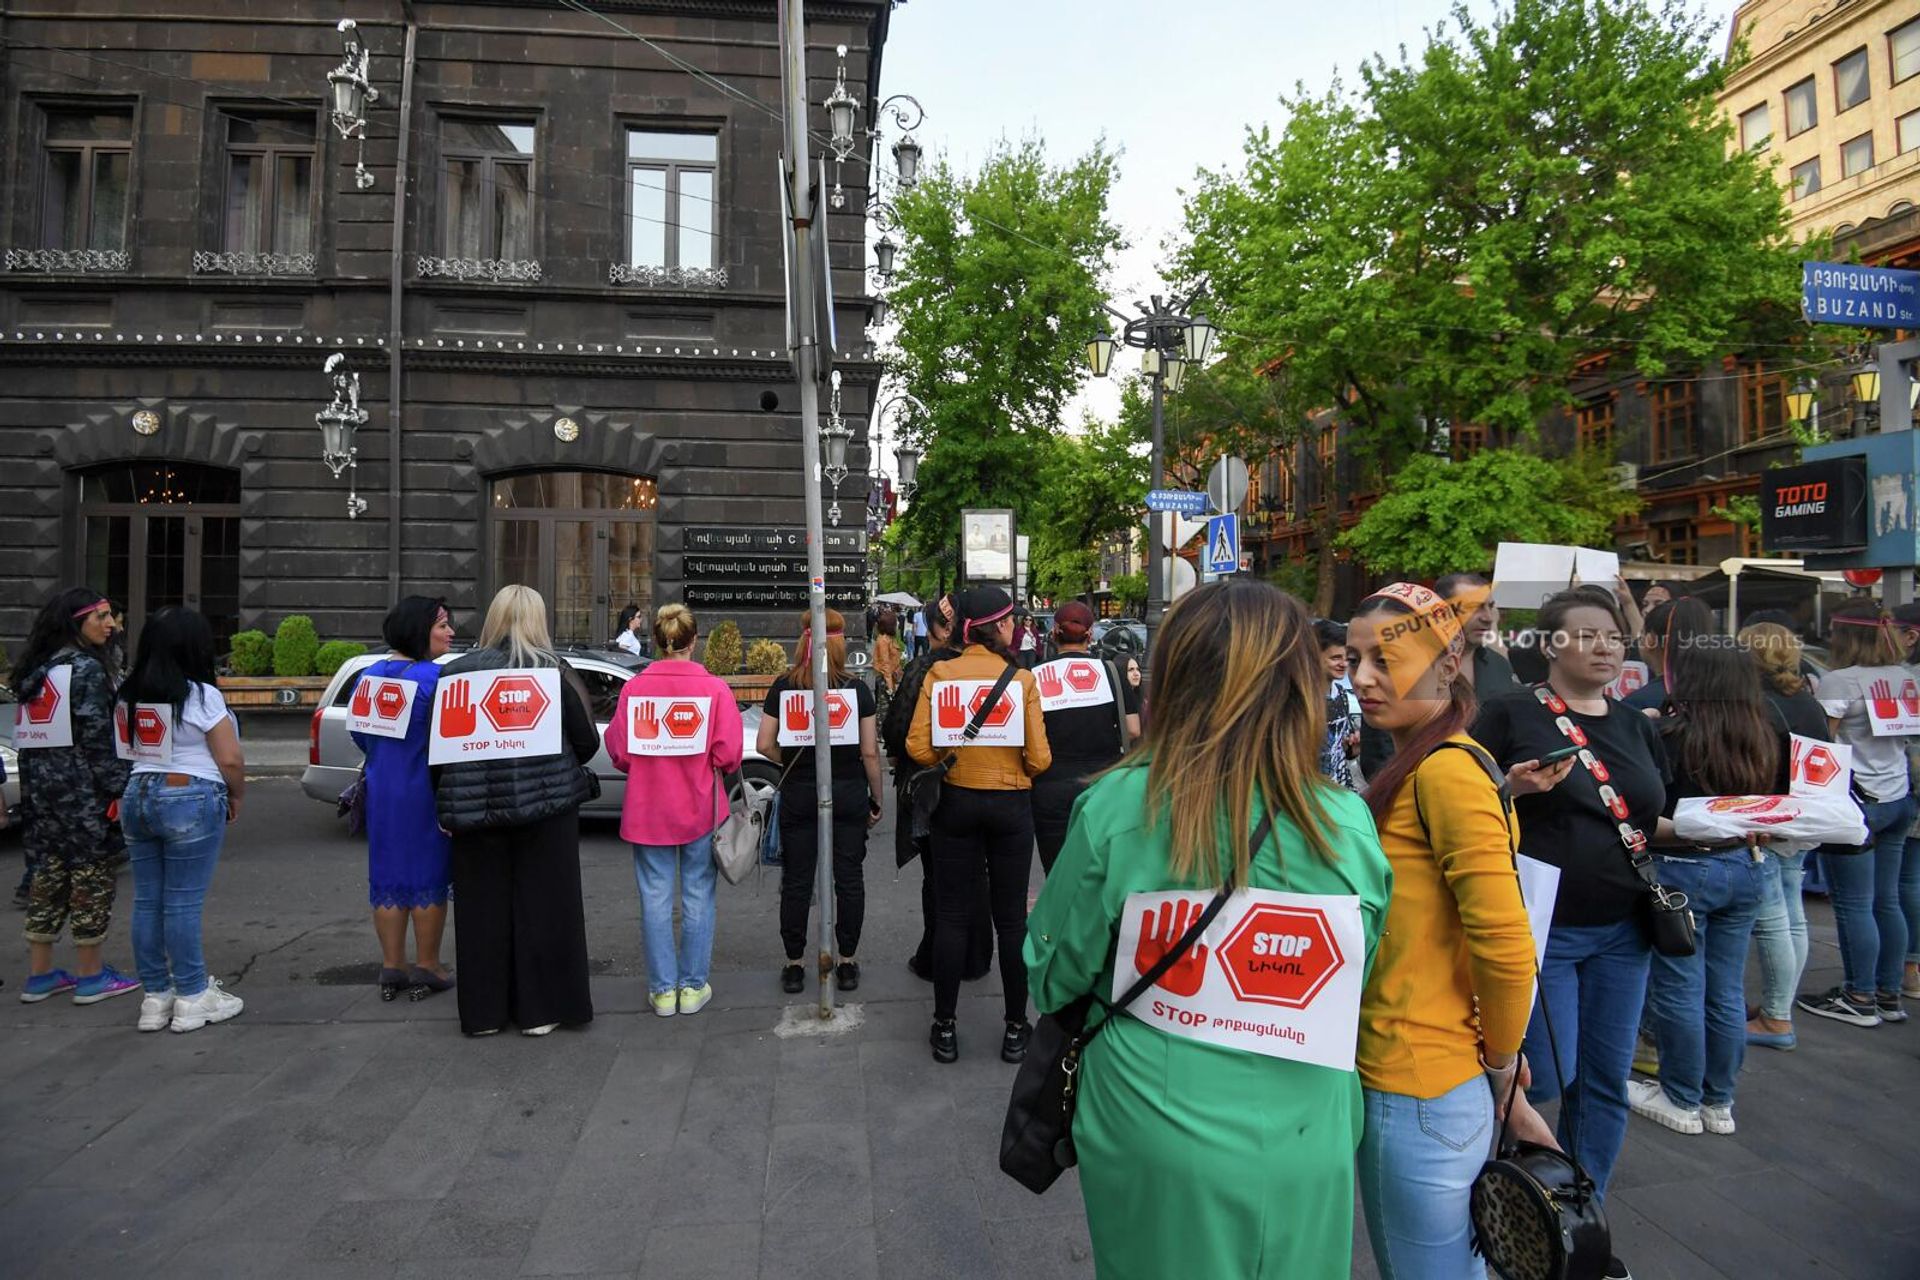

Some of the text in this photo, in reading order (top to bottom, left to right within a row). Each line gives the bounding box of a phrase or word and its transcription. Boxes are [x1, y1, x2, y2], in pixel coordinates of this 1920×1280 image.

[1817, 298, 1897, 319] BUZAND
[1776, 482, 1827, 505] TOTO
[1774, 501, 1826, 518] GAMING
[855, 652, 867, 665] D
[283, 689, 295, 703] D
[382, 692, 399, 702] STOP
[499, 690, 532, 704] STOP
[673, 711, 694, 721] STOP
[462, 741, 490, 751] STOP
[1252, 932, 1312, 957] STOP
[1248, 960, 1306, 976] ՆԻԿՈԼ
[1152, 1000, 1208, 1028] STOP
